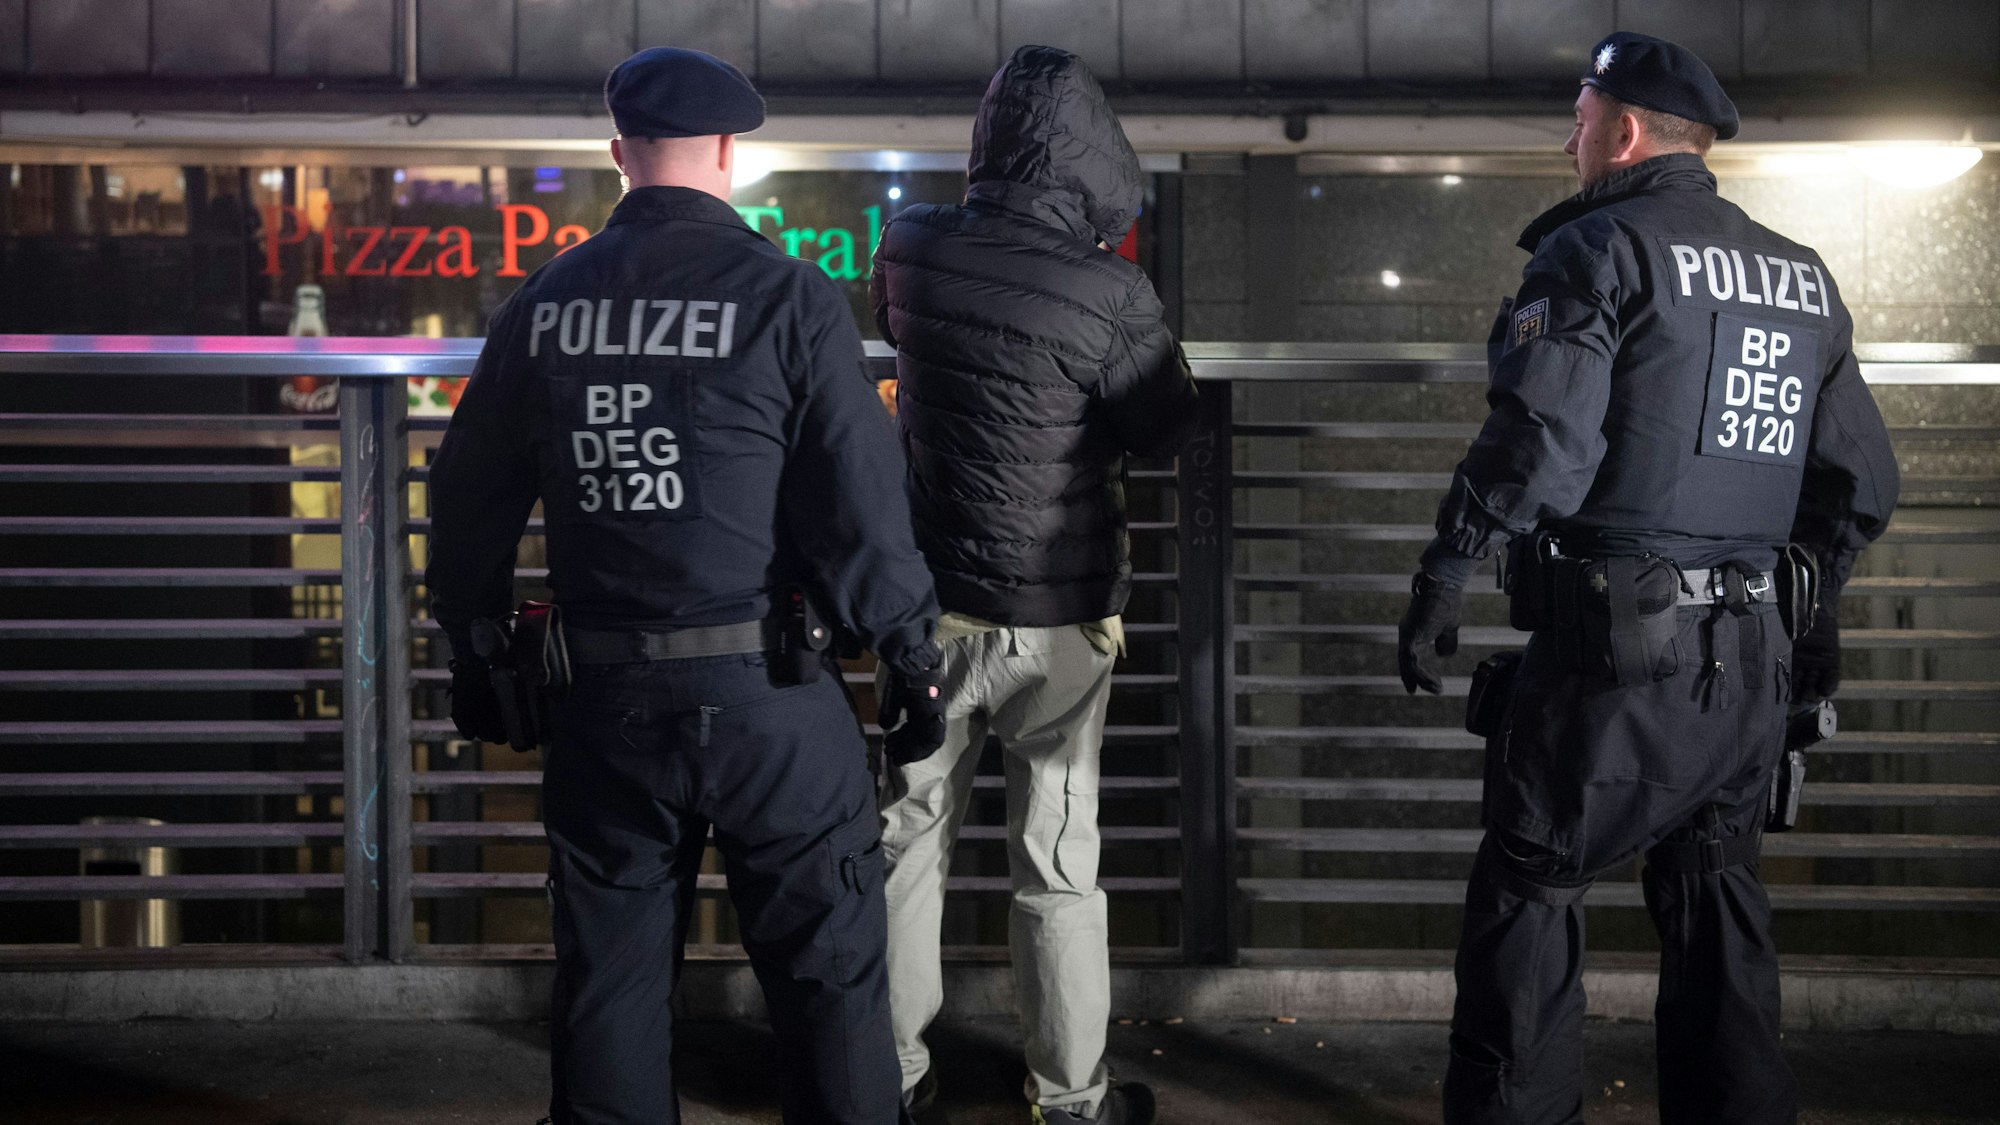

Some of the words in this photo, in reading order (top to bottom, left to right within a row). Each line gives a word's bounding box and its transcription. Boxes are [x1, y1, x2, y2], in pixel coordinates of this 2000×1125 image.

[262, 203, 479, 277] Pizza
[1670, 244, 1829, 317] POLIZEI
[529, 298, 738, 358] POLIZEI
[1518, 302, 1545, 324] POLIZEI
[1741, 326, 1791, 369] BP
[587, 383, 653, 425] BP
[1725, 367, 1802, 414] DEG
[571, 426, 680, 469] DEG
[1717, 410, 1794, 456] 3120
[578, 470, 684, 513] 3120
